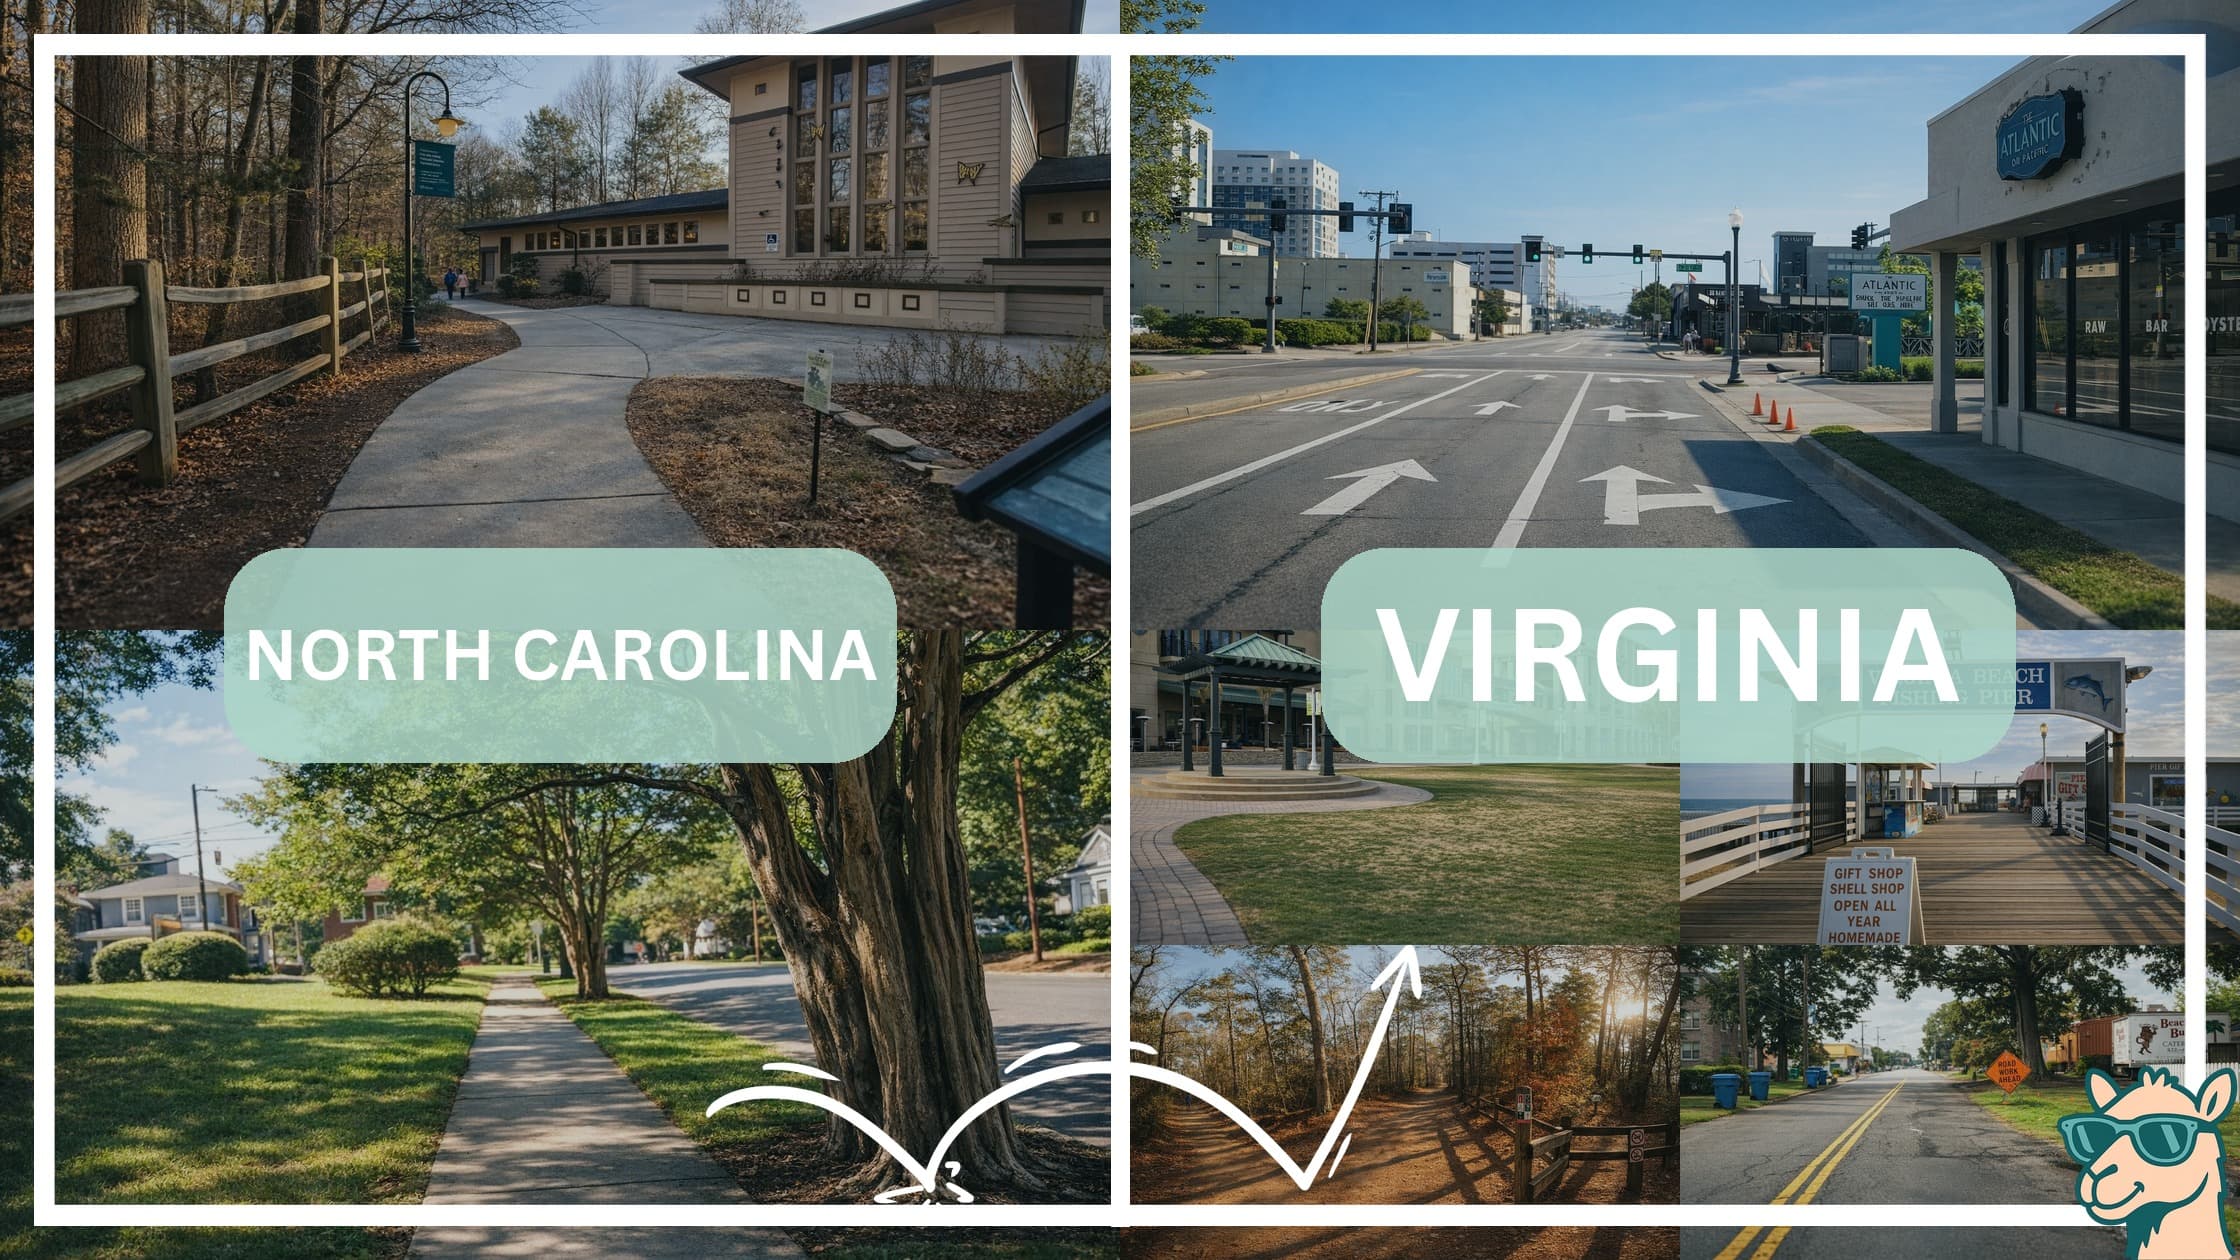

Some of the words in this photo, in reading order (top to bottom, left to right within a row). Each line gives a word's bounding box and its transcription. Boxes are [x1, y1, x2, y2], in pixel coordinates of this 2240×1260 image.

[2000, 112, 2060, 159] ATLANTIC
[1862, 280, 1918, 291] ATLANTIC
[2085, 320, 2107, 334] RAW
[2145, 319, 2168, 333] BAR
[2058, 783, 2078, 793] GIFT
[1834, 868, 1862, 879] GIFT
[1868, 868, 1904, 879] SHOP
[1830, 883, 1867, 894] SHELL
[1871, 883, 1905, 894] SHOP
[1834, 900, 1868, 911] OPEN
[1874, 900, 1897, 911] ALL
[1848, 916, 1881, 927] YEAR
[1828, 932, 1901, 943] HOMEMADE
[2160, 1019, 2185, 1028] Beac
[1999, 1075, 2021, 1083] AHEAD
